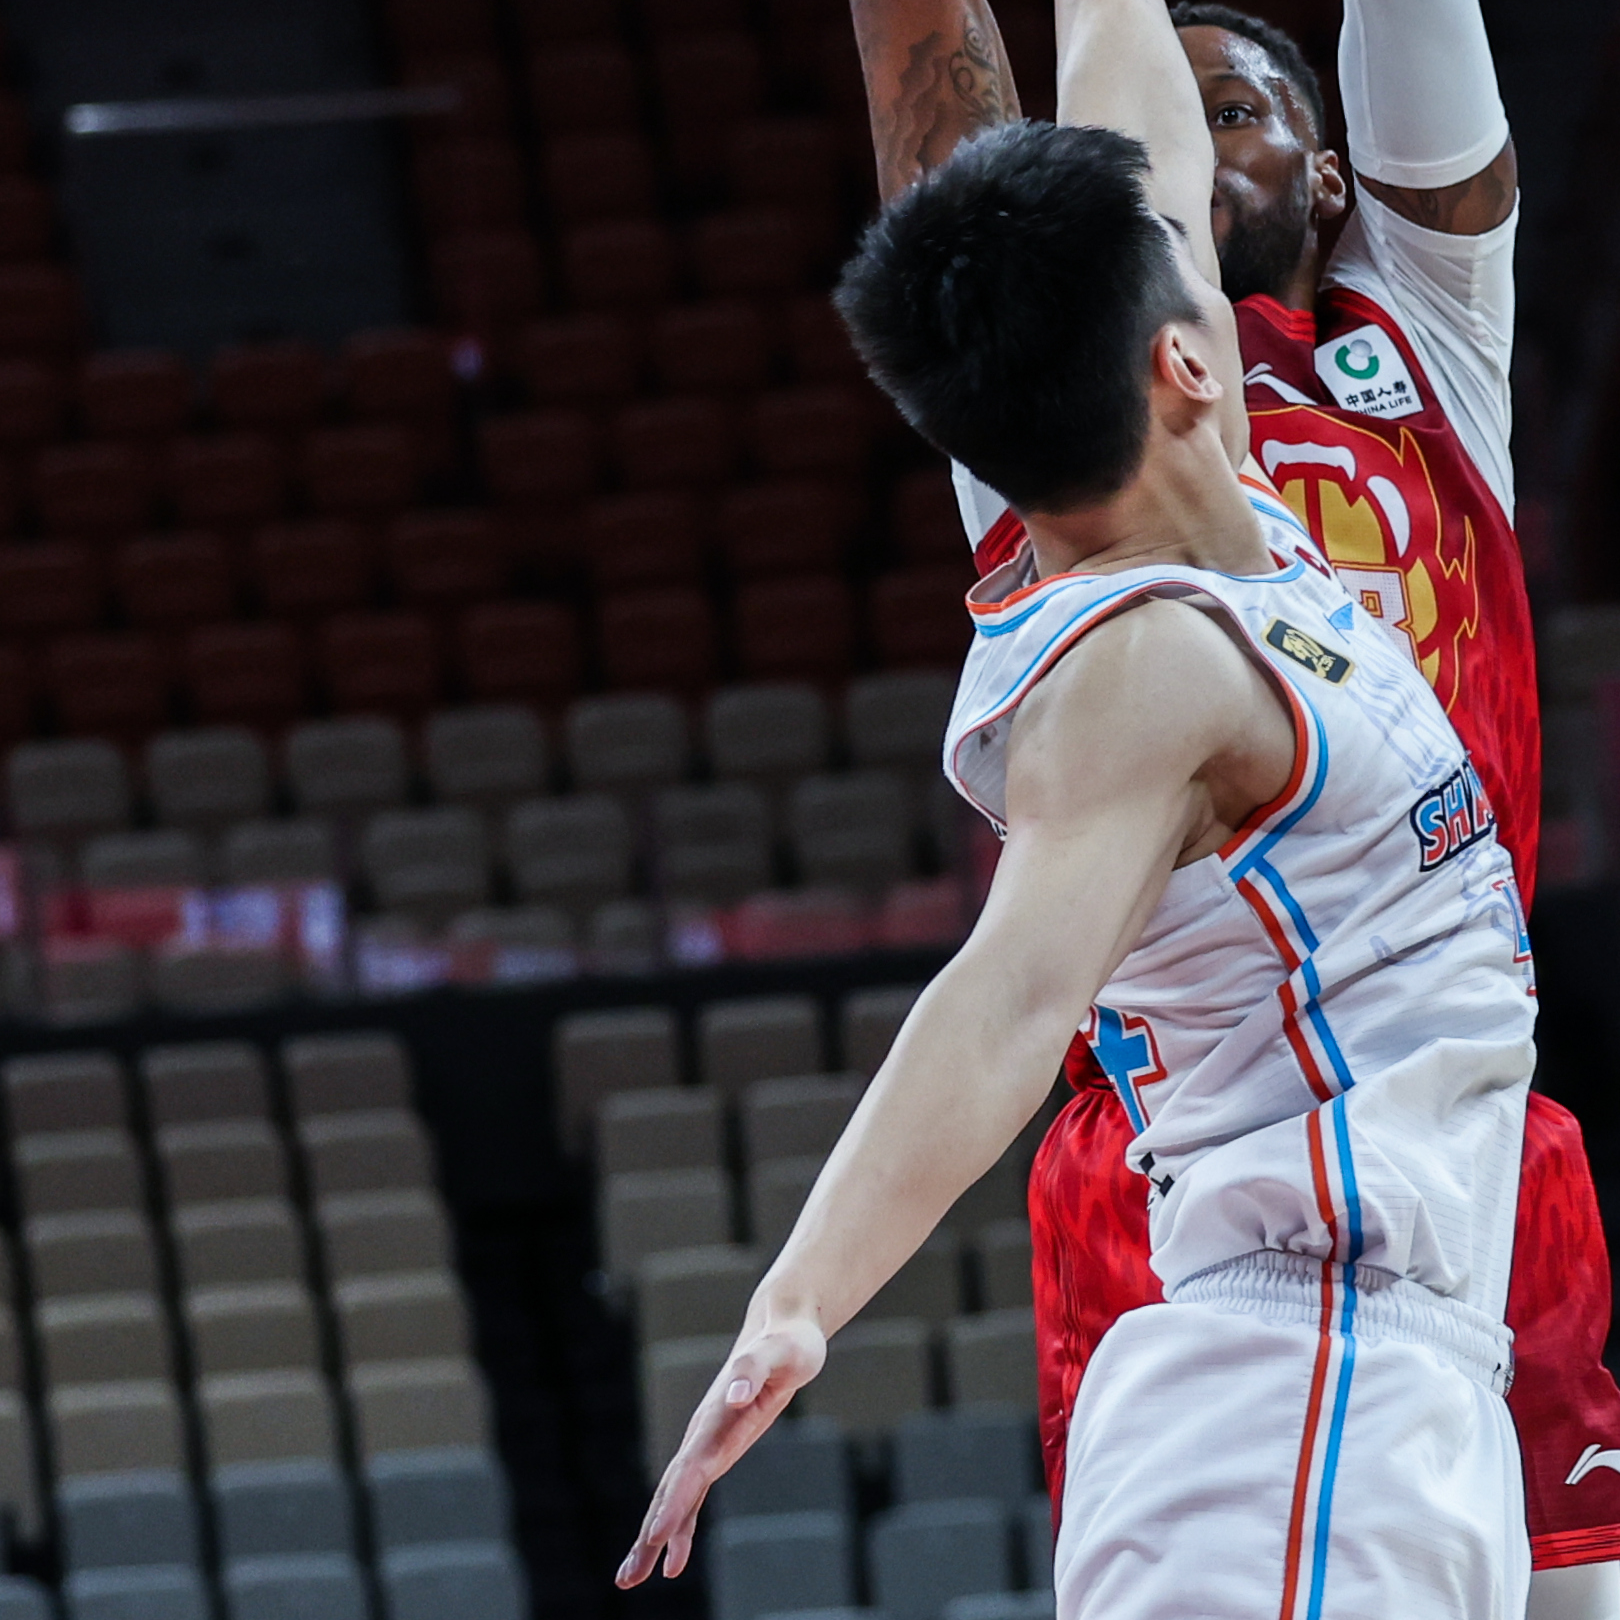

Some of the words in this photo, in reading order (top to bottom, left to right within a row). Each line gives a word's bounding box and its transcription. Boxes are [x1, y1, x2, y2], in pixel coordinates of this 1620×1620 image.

[1345, 380, 1407, 408] 中国人寿
[1355, 403, 1387, 416] HINA
[1388, 395, 1413, 409] LIFE
